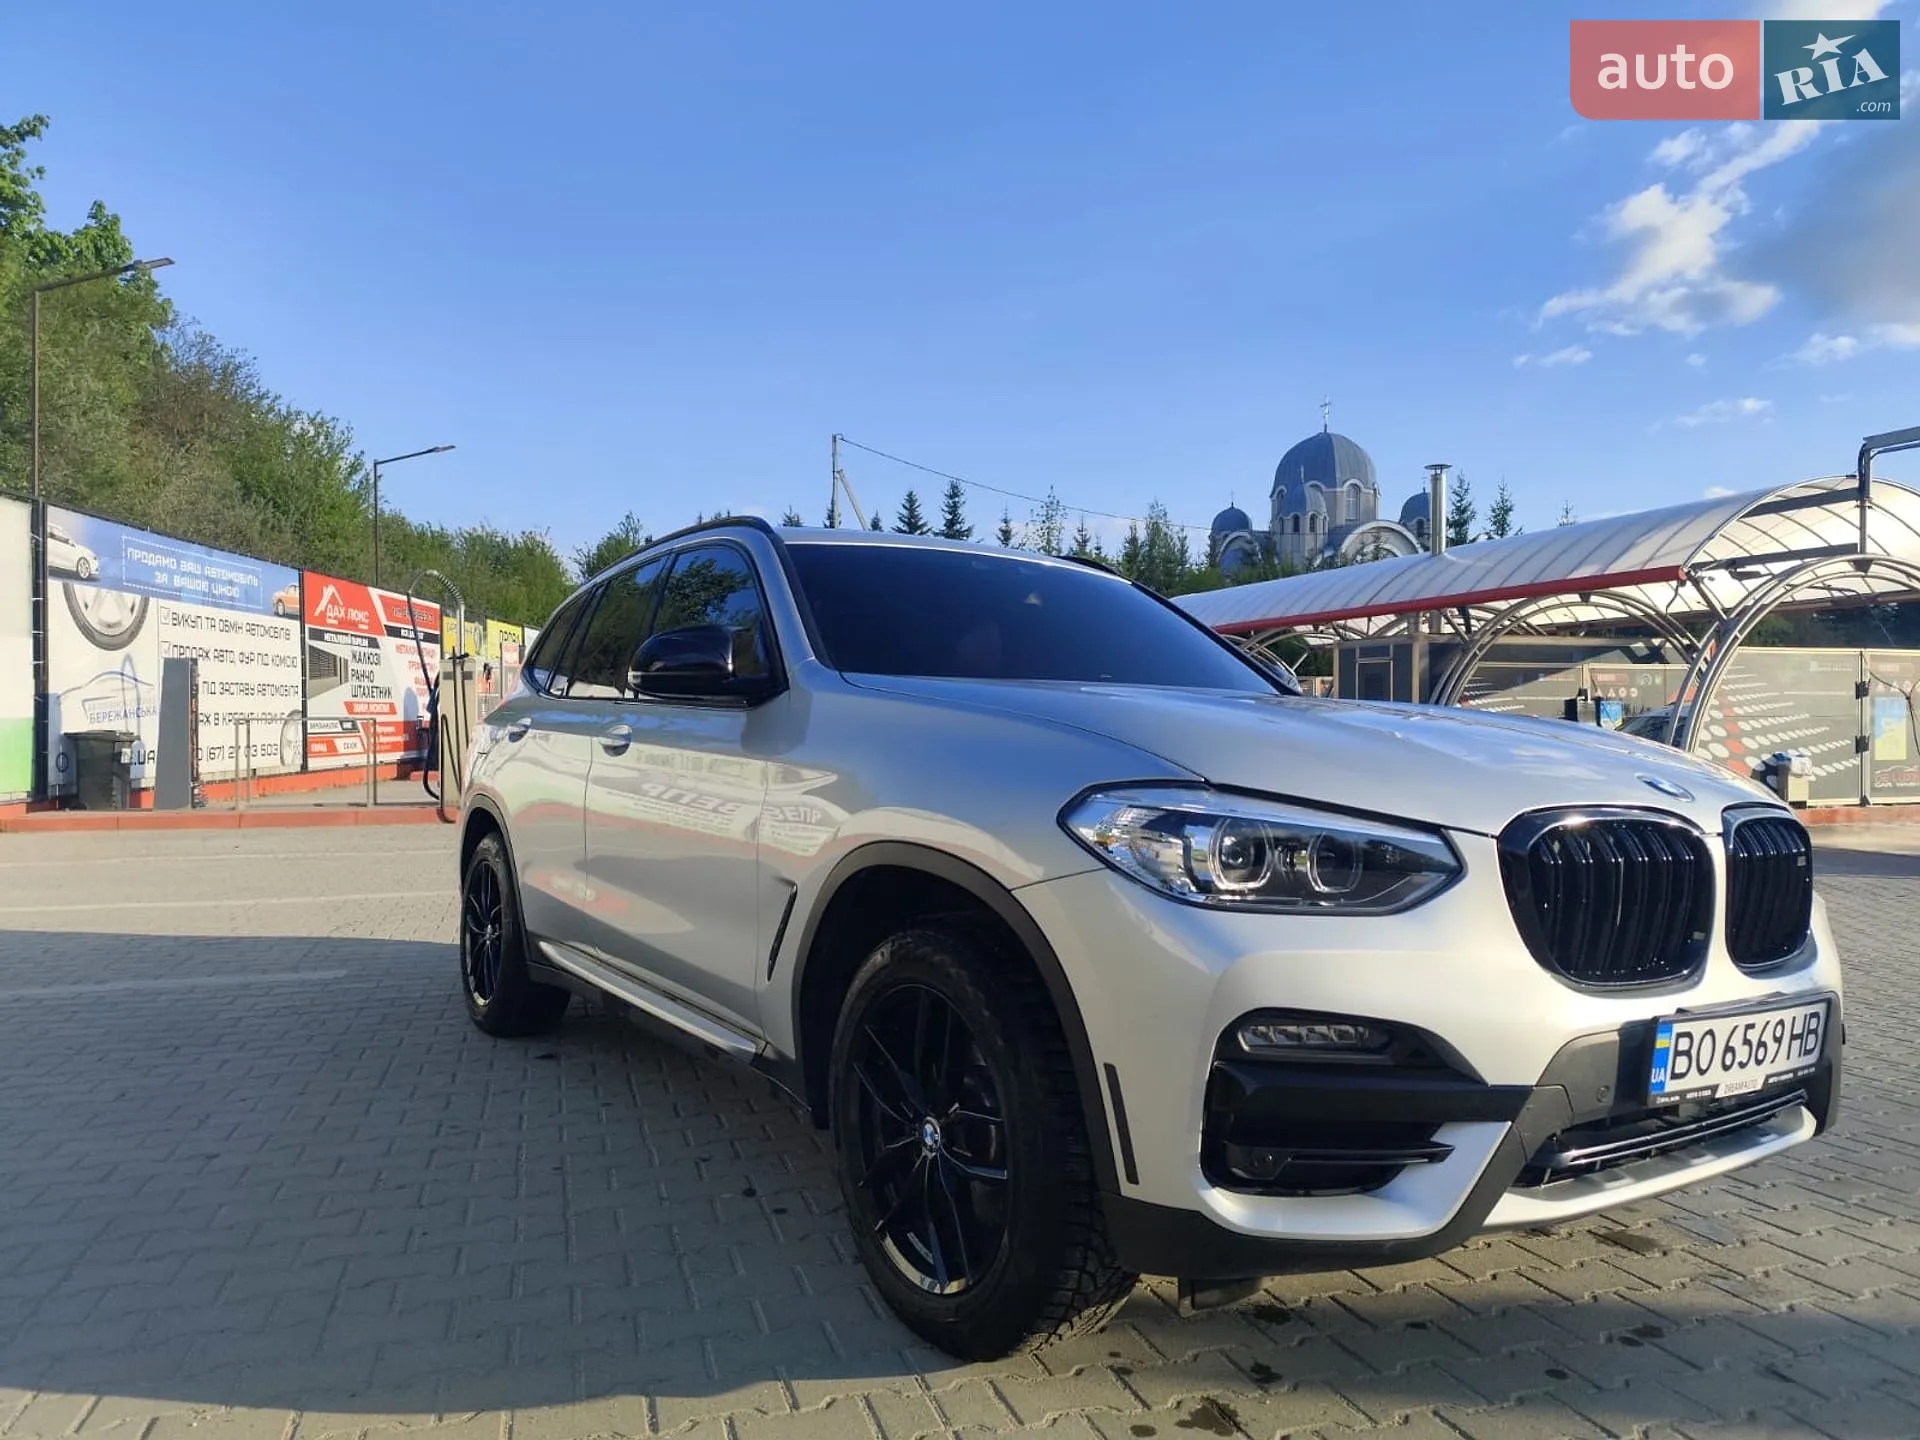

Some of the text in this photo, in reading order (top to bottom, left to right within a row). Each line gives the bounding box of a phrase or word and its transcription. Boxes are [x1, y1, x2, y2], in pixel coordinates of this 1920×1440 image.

[126, 547, 259, 587] ПРОДАМО ВАШ АВТОМОБІЛЬ
[154, 571, 240, 598] ЗА ВАШОЮ ЦІНОЮ
[327, 603, 369, 622] ДАХ ЛЮКС
[171, 611, 203, 630] ВИКУП
[205, 616, 217, 631] ТА
[219, 618, 244, 635] ОБМІН
[238, 651, 255, 665] ФУР
[351, 649, 381, 666] ЖАЛЮЗІ
[351, 668, 375, 683] РАНЧО
[219, 681, 255, 697] ЗАСТАВУ
[351, 684, 393, 700] ШТАХЕТНИК
[1670, 1010, 1822, 1081] BO 6569 HB
[1651, 1067, 1666, 1085] UA
